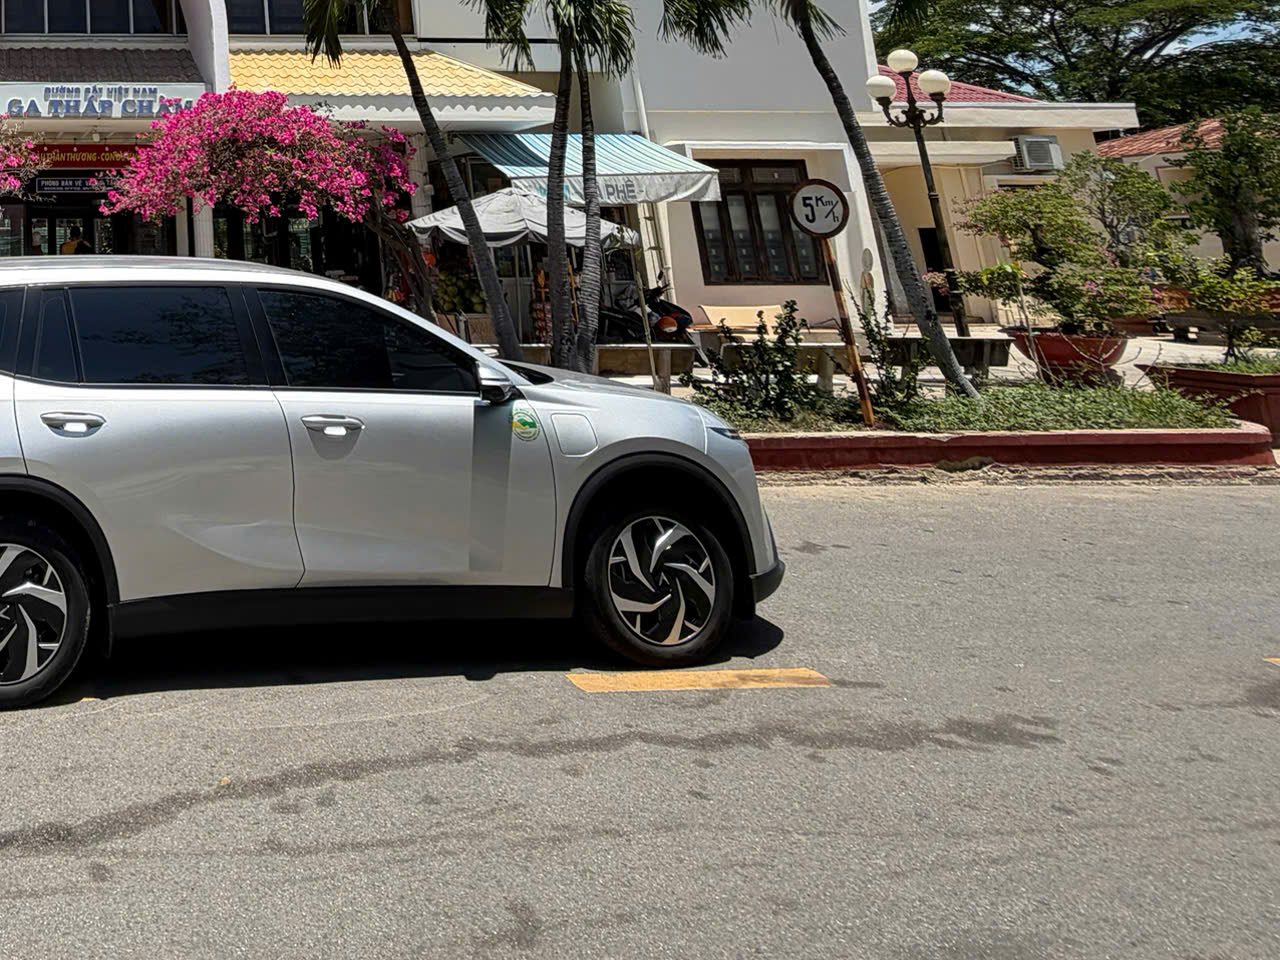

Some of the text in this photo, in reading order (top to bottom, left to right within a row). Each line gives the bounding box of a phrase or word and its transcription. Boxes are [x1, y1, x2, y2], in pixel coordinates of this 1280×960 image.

[133, 87, 158, 97] NAM
[7, 100, 41, 116] GA
[49, 94, 114, 116] THÁP
